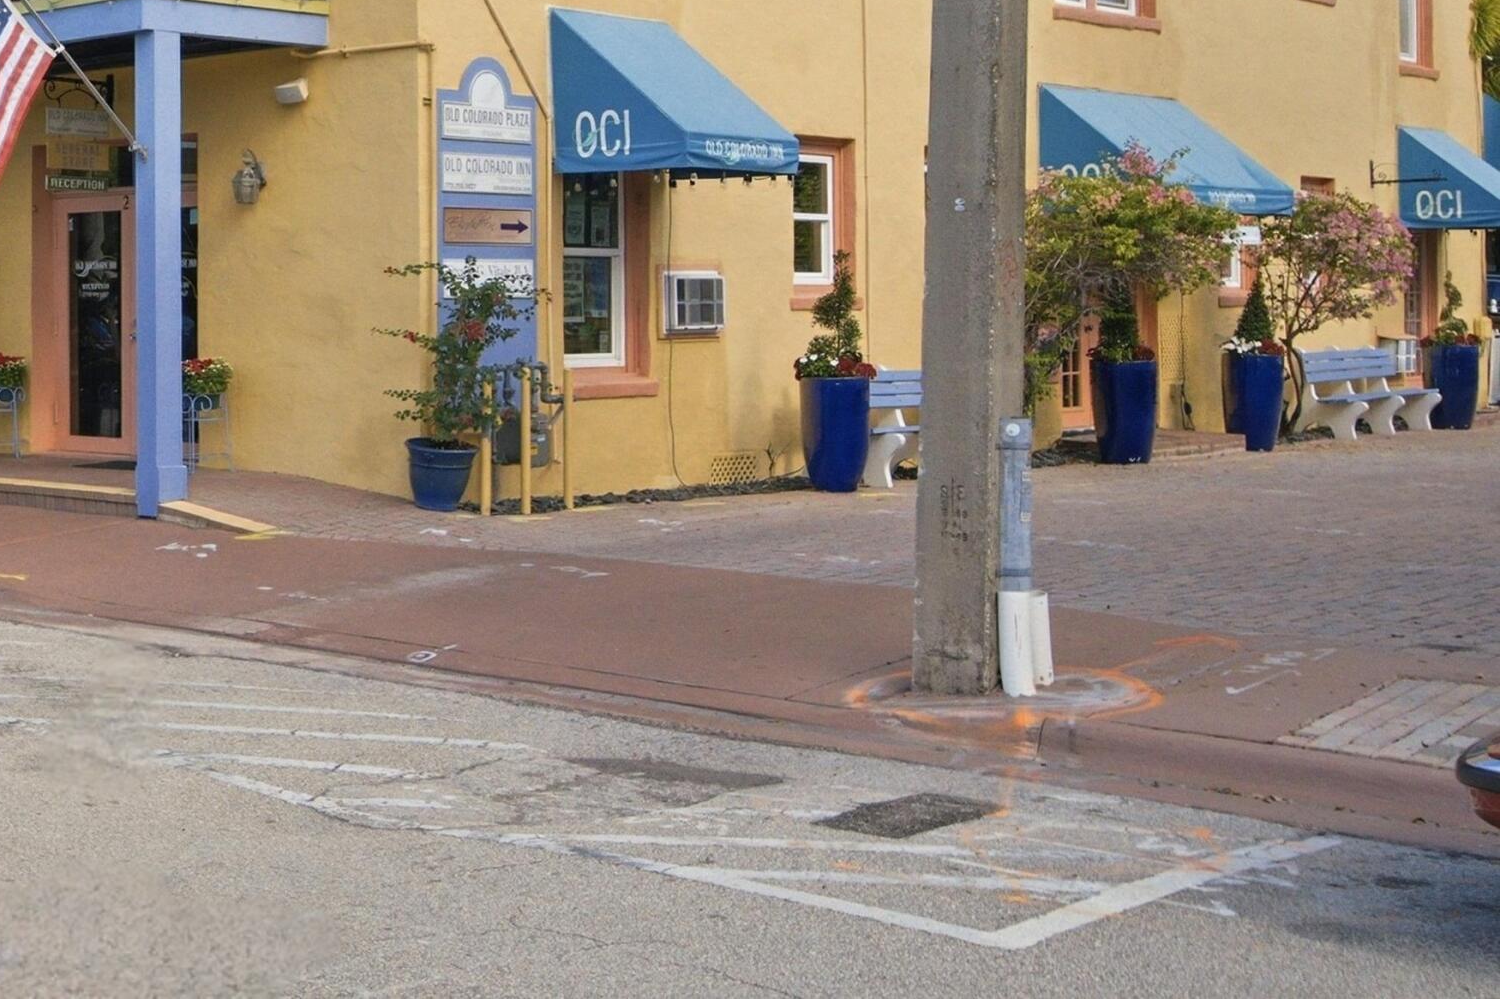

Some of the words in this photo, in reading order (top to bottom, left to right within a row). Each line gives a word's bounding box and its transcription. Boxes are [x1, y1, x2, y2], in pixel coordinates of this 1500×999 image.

[445, 107, 460, 122] OLD
[462, 109, 504, 126] COLORADO
[505, 113, 529, 128] PLAZA
[575, 109, 631, 159] OCI
[705, 140, 723, 156] OLD
[444, 157, 462, 172] OLD
[465, 158, 513, 176] COLORADO
[514, 161, 532, 177] INN
[50, 178, 105, 190] RECEPTION
[122, 194, 130, 210] 2
[1415, 189, 1462, 220] OCI
